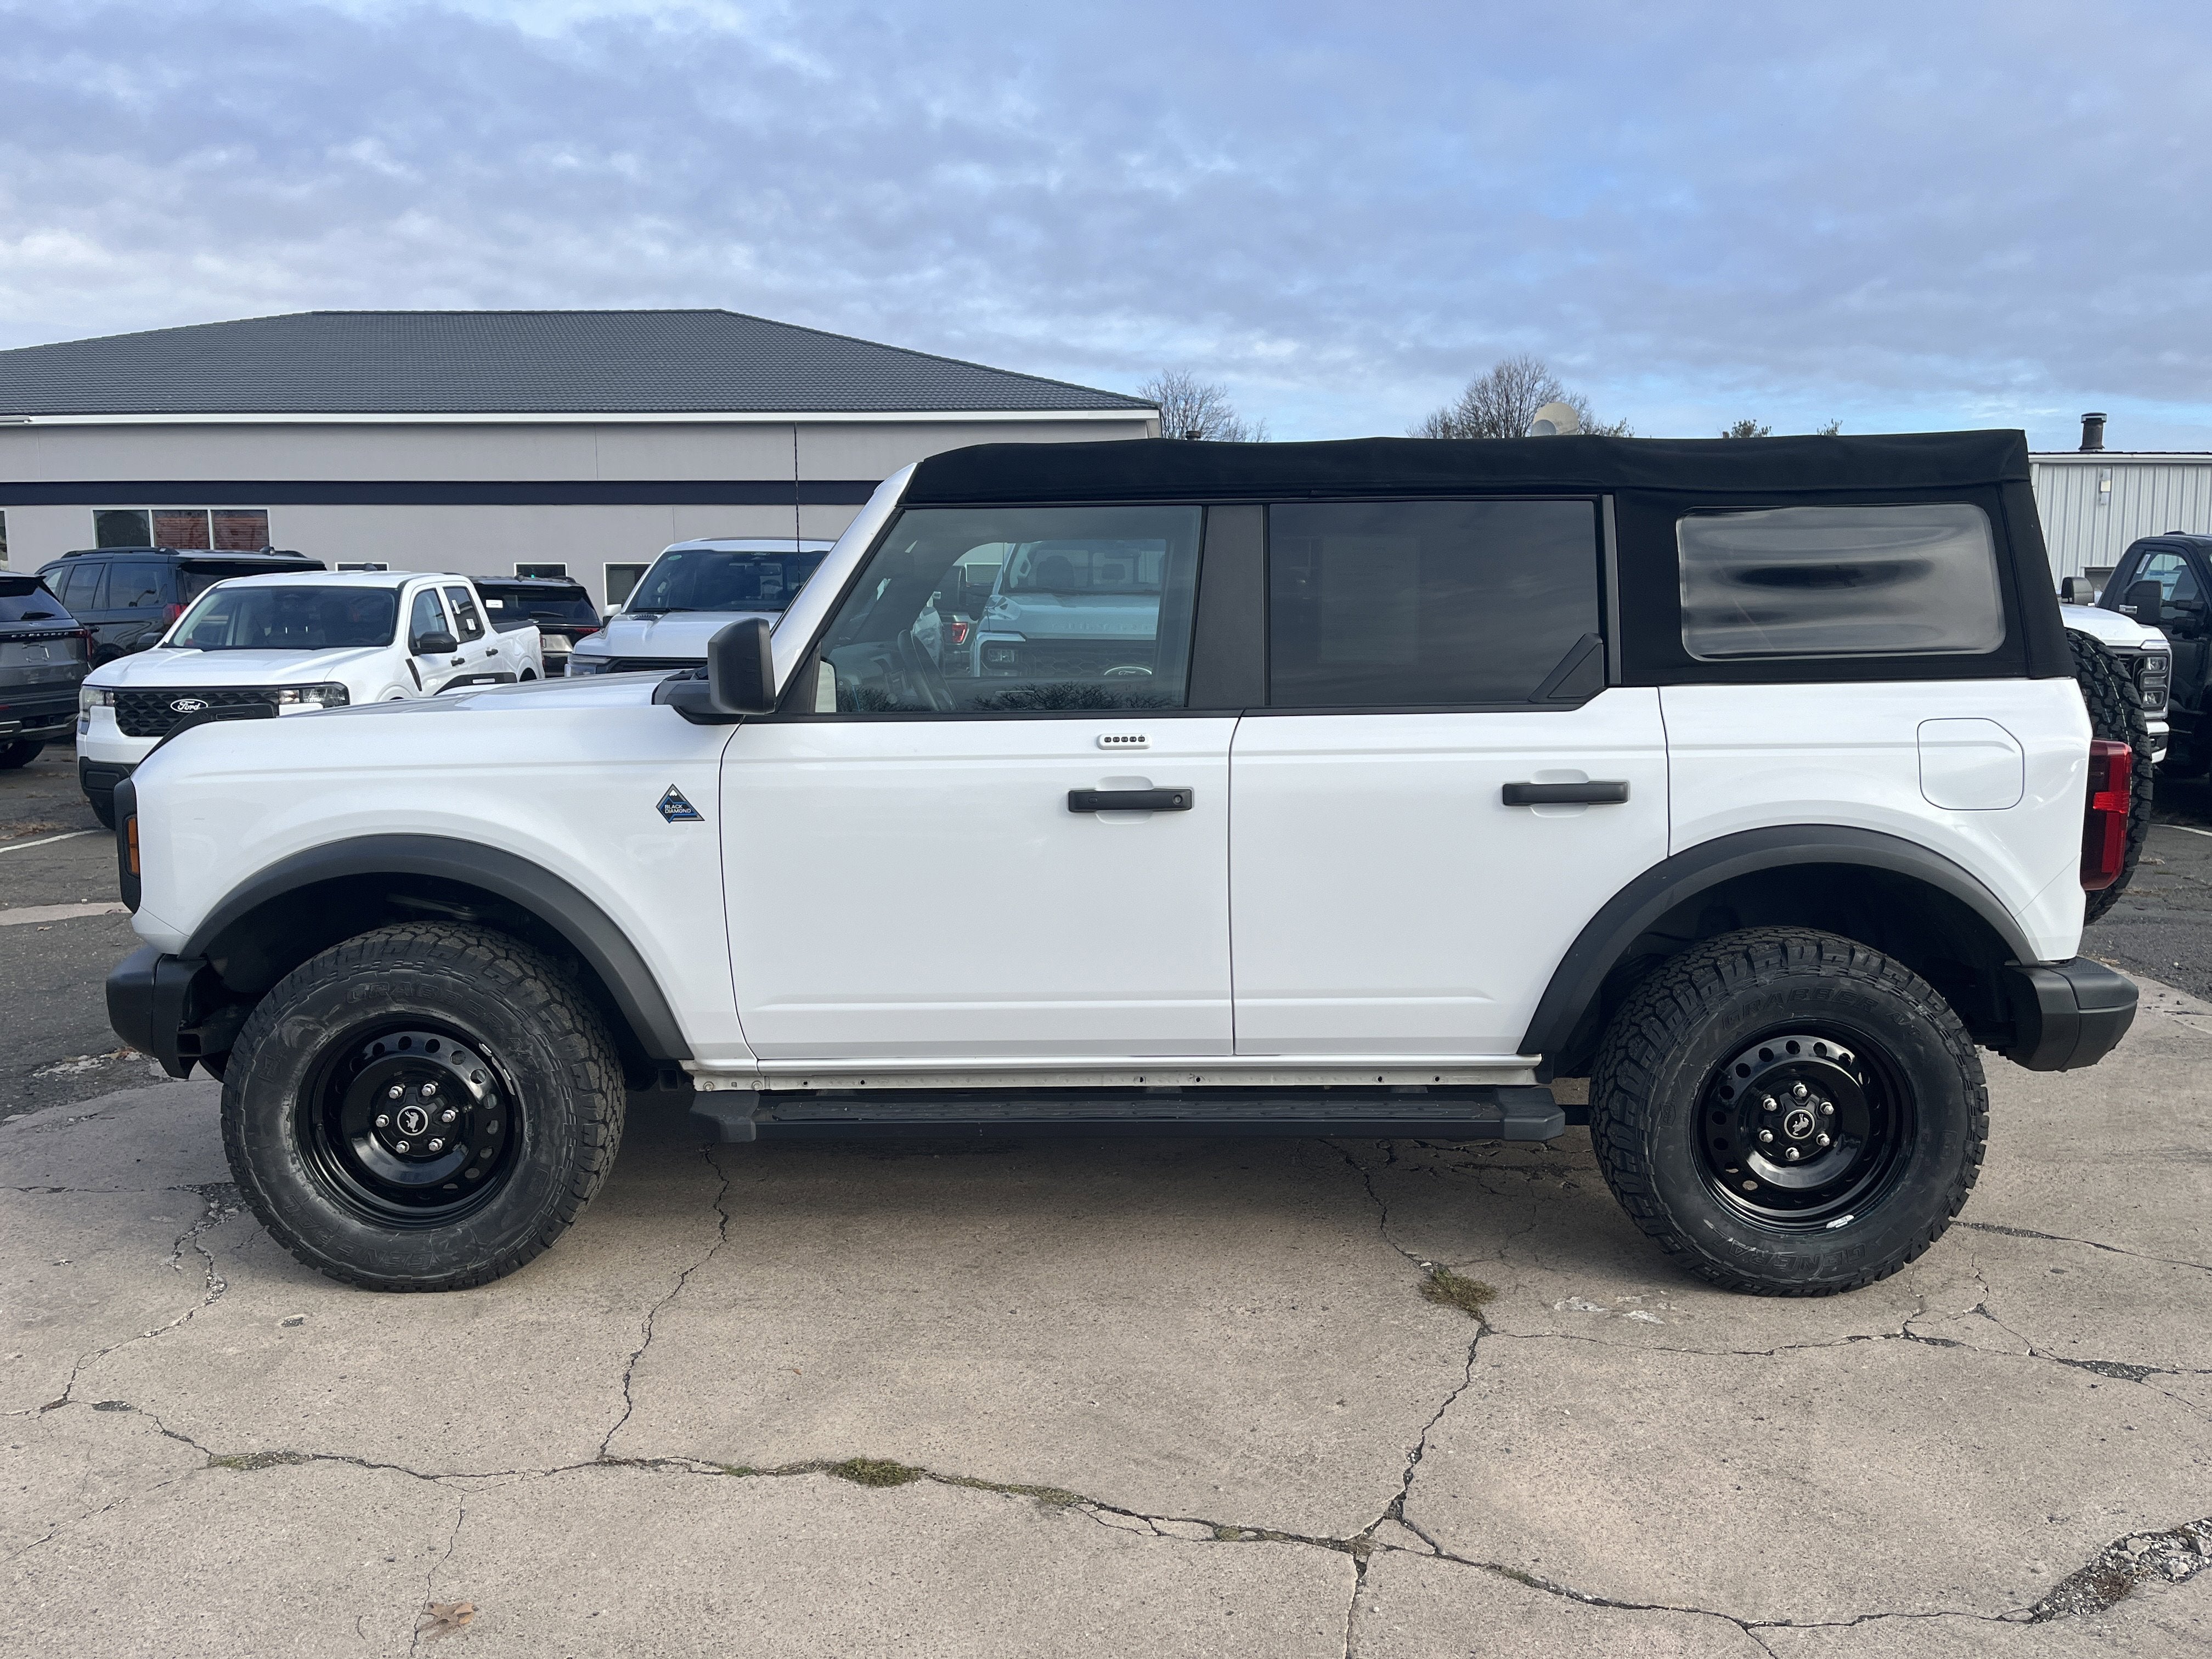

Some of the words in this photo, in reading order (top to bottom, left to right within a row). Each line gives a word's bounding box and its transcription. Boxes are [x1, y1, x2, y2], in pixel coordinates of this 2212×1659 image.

[177, 701, 201, 710] Ford
[346, 981, 505, 1030] GRABBER
[1722, 987, 1880, 1030] GRABBER
[284, 1193, 432, 1268] GENERAL
[1713, 1232, 1866, 1271] GENERAL
